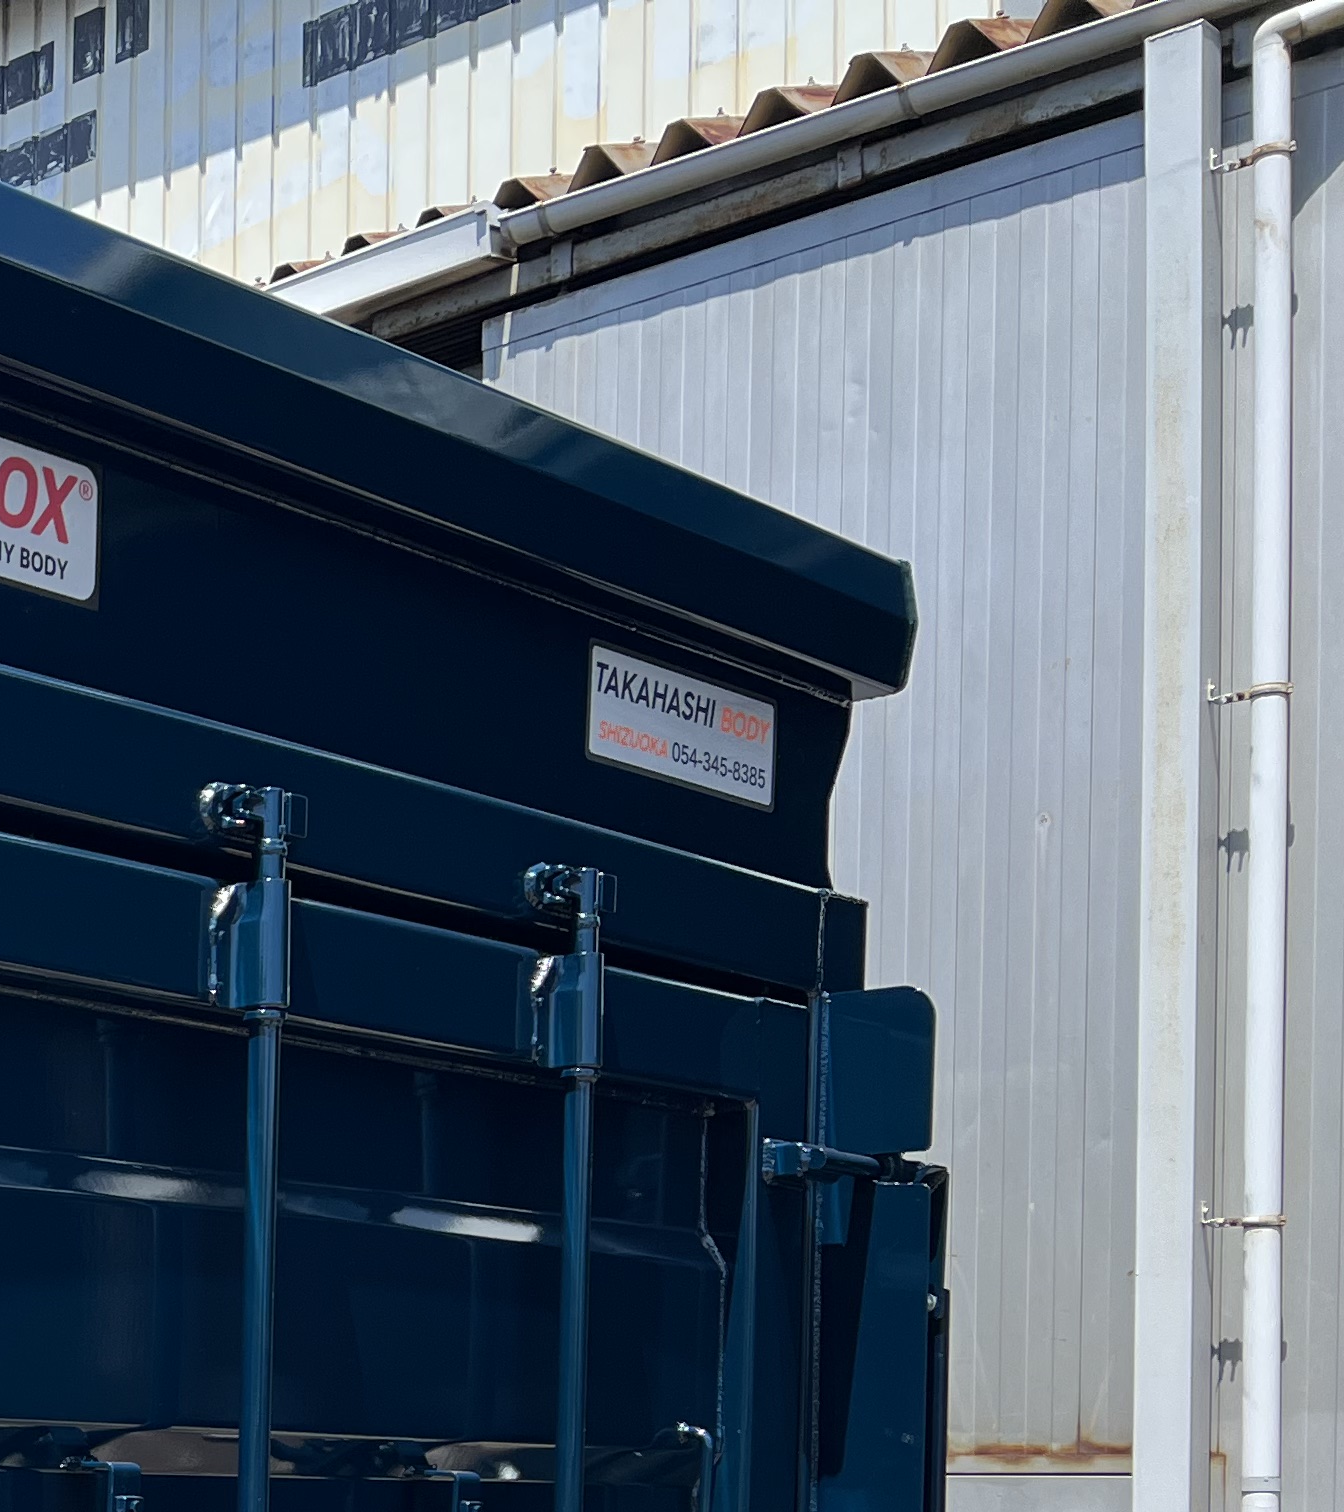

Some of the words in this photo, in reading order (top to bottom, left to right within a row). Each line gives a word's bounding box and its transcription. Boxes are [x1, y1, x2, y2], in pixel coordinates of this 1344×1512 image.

[20, 547, 68, 580] BODY
[596, 661, 716, 729] TAKAHASHI
[720, 706, 771, 744] BODY
[598, 720, 669, 759] SHIZUOKA
[672, 741, 766, 789] 054-345-8385
